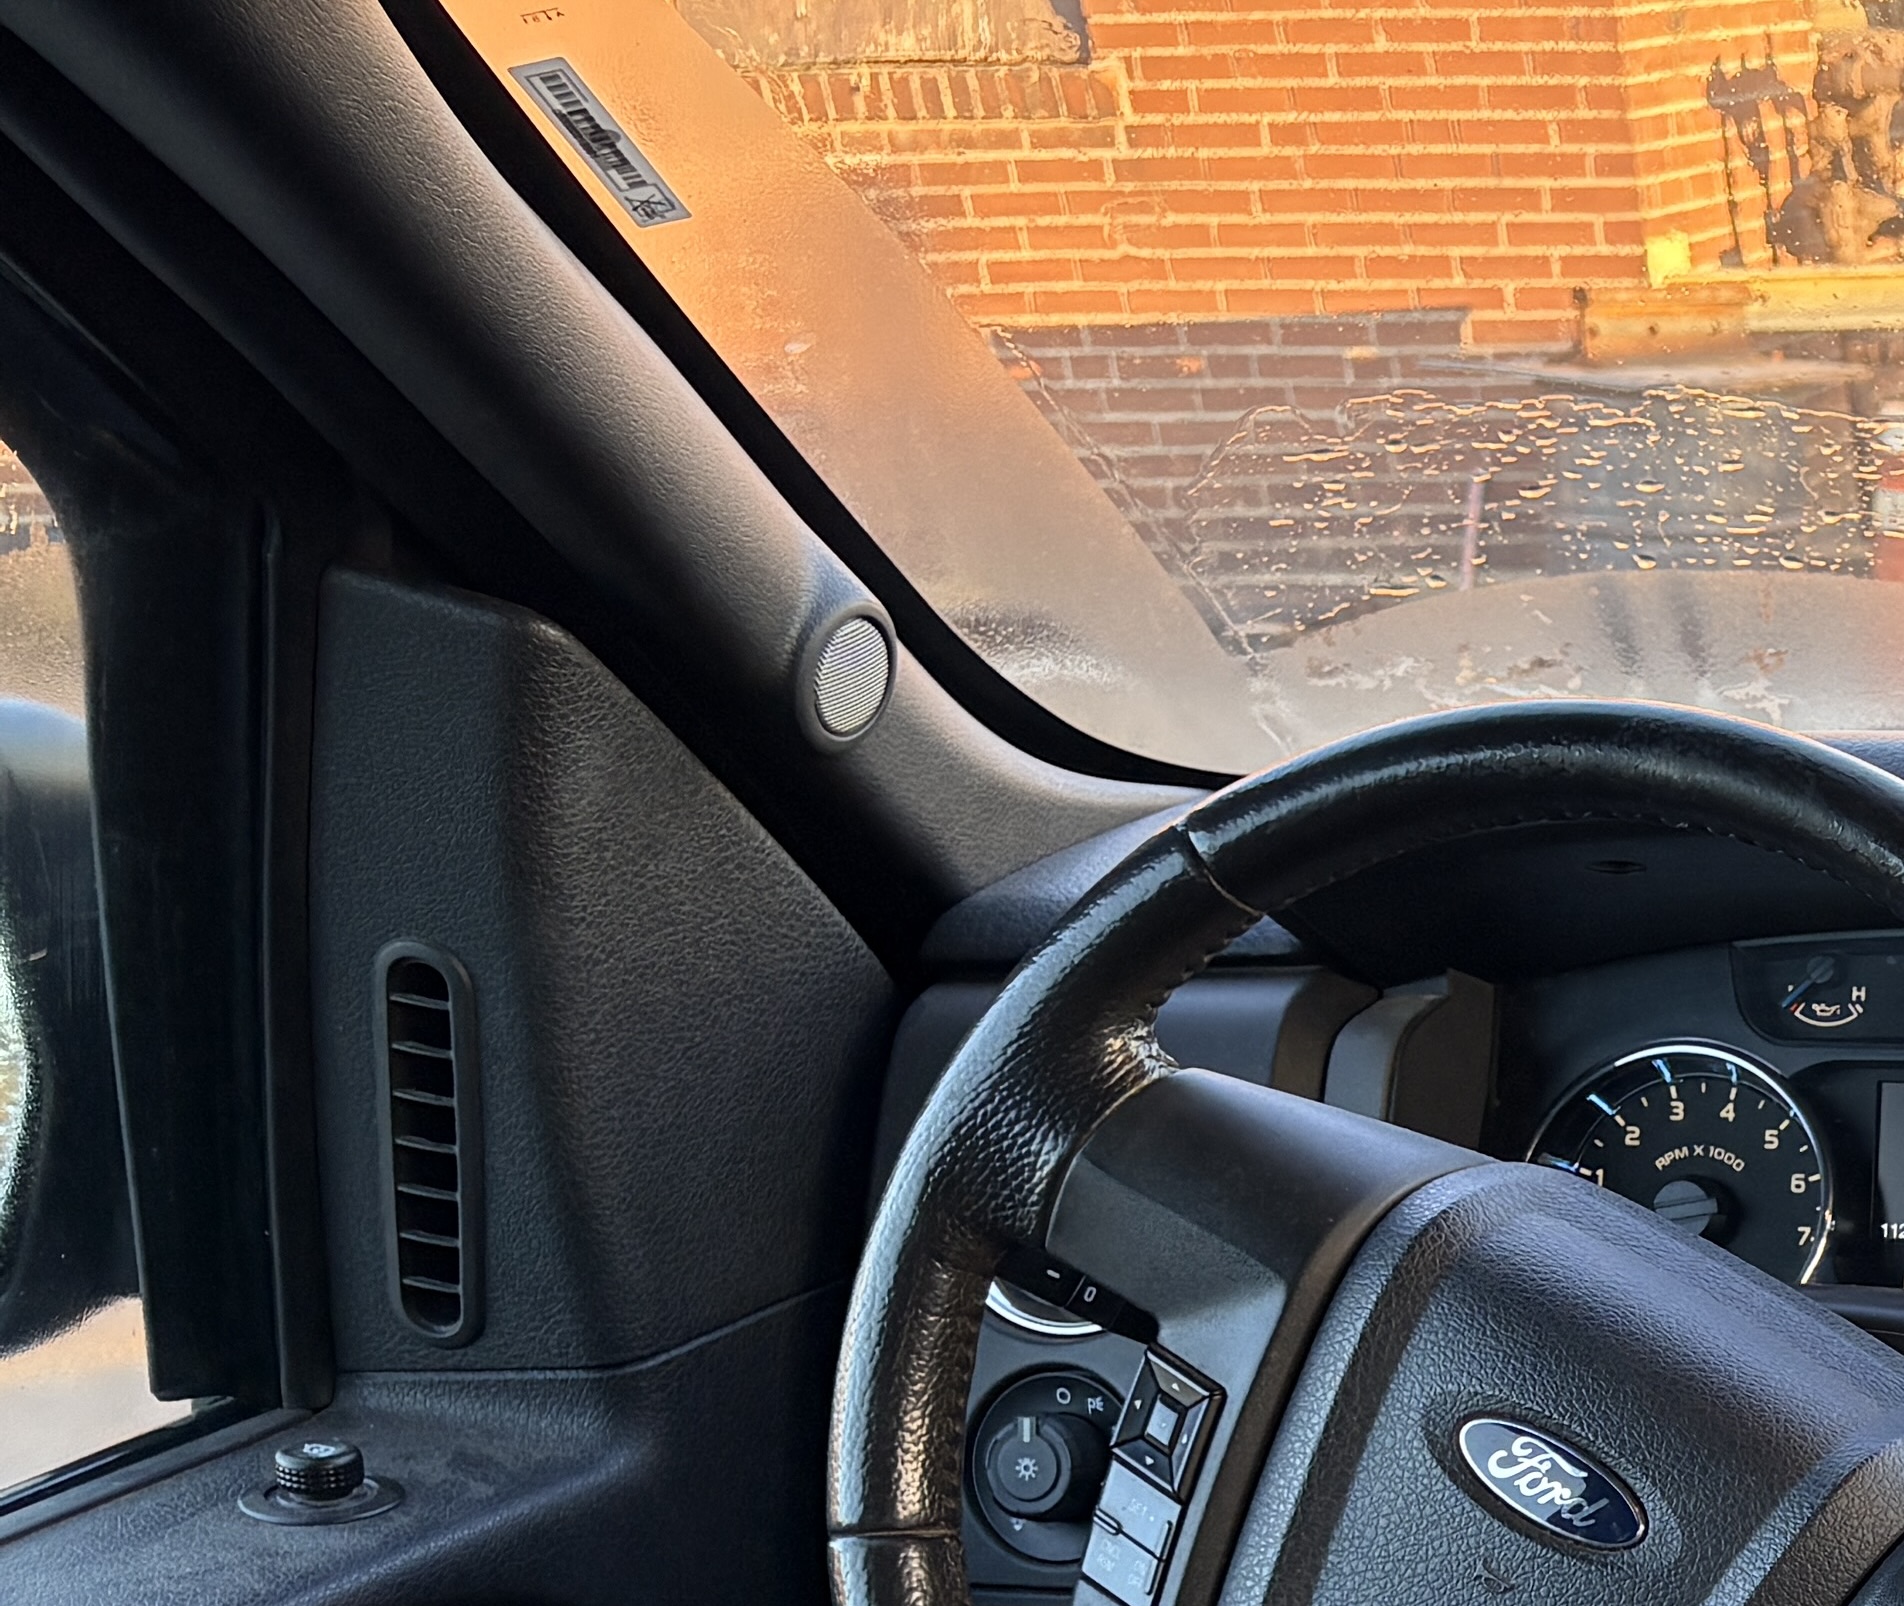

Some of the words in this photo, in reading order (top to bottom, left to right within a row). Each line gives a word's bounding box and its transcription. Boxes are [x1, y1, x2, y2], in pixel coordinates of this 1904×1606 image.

[1852, 986, 1866, 1002] H
[1669, 1102, 1685, 1121] 3
[1719, 1103, 1735, 1122] 4
[1624, 1126, 1641, 1146] 2
[1764, 1129, 1779, 1149] 5
[1655, 1146, 1689, 1171] RPM
[1709, 1146, 1746, 1172] 1000
[1596, 1169, 1604, 1187] 1
[1790, 1174, 1806, 1193] 6
[1797, 1226, 1811, 1245] 7
[1487, 1435, 1610, 1528] Ford
